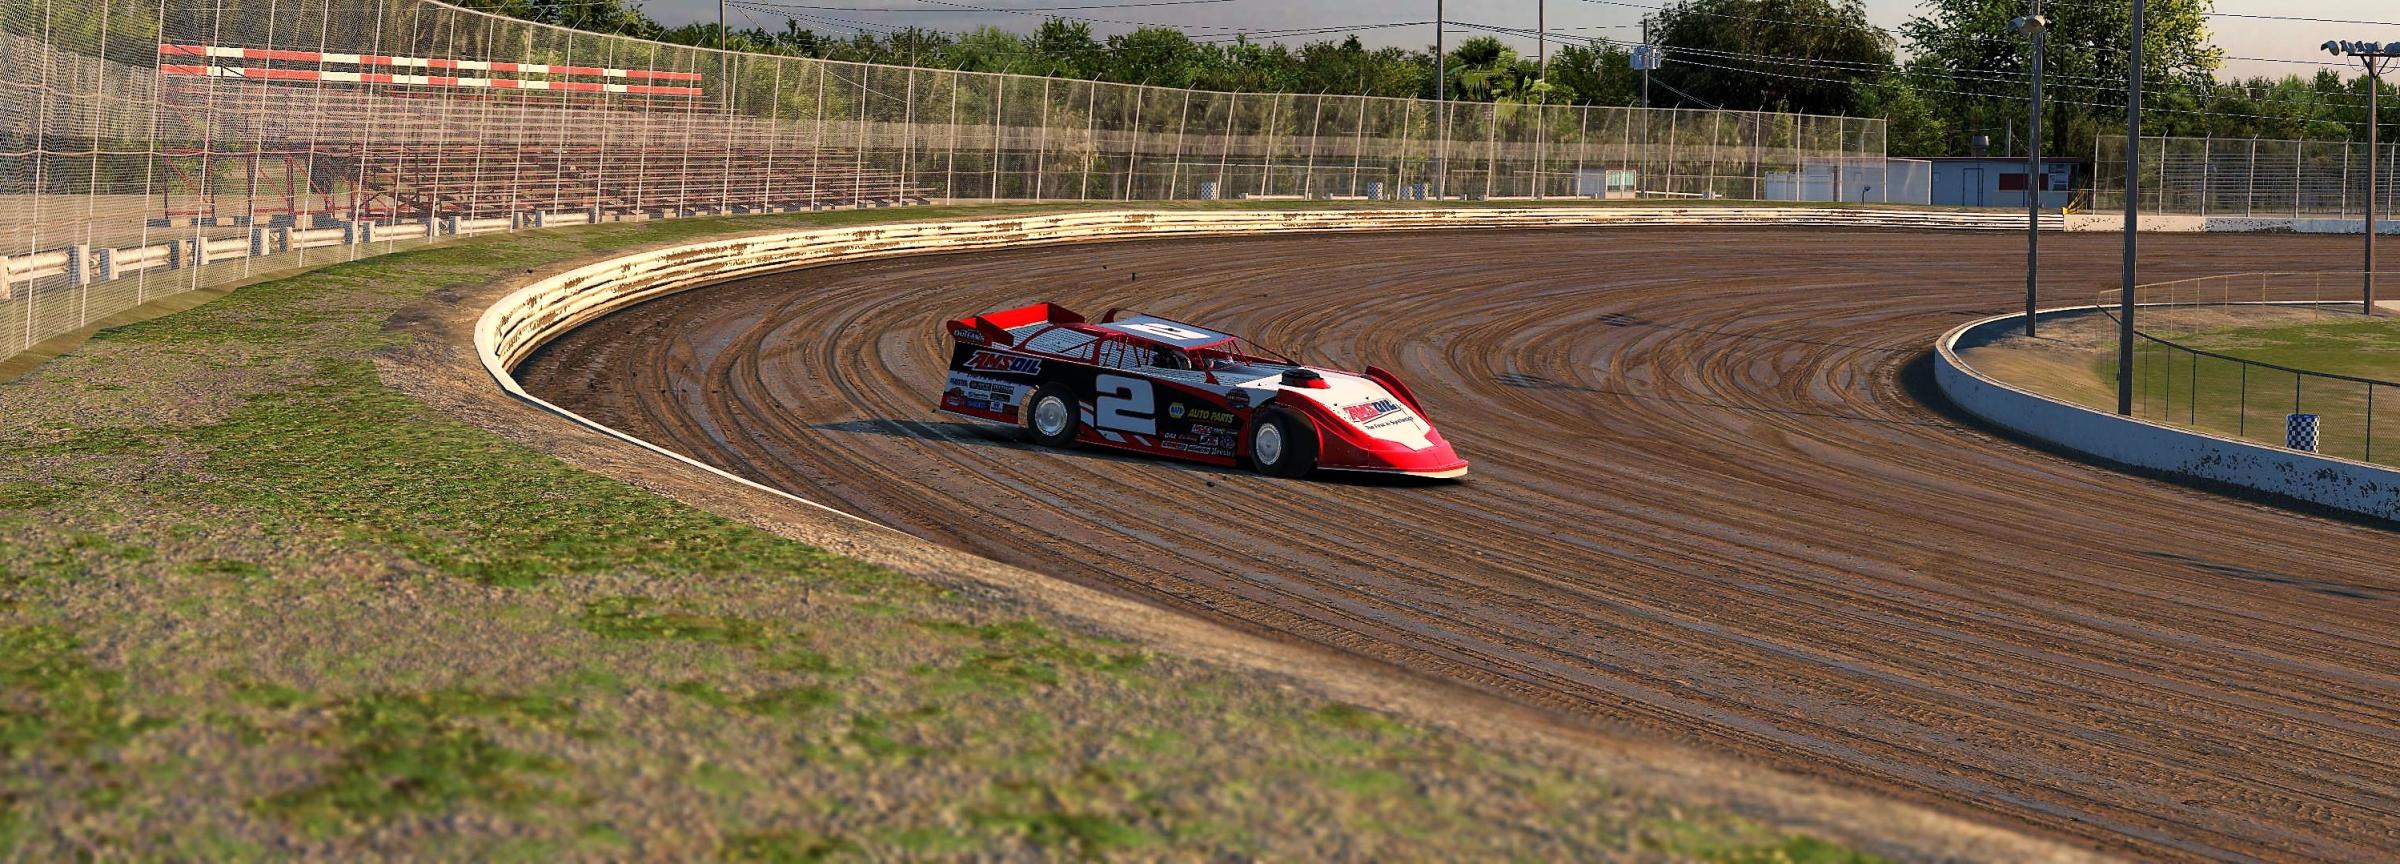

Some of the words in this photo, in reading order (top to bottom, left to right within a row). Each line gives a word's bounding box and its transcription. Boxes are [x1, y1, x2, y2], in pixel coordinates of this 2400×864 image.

[964, 350, 1041, 375] AMSOIL
[1096, 374, 1157, 435] 2
[1187, 408, 1210, 419] AUTO
[1210, 411, 1235, 423] PARTS
[1342, 399, 1398, 422] AMSOIL
